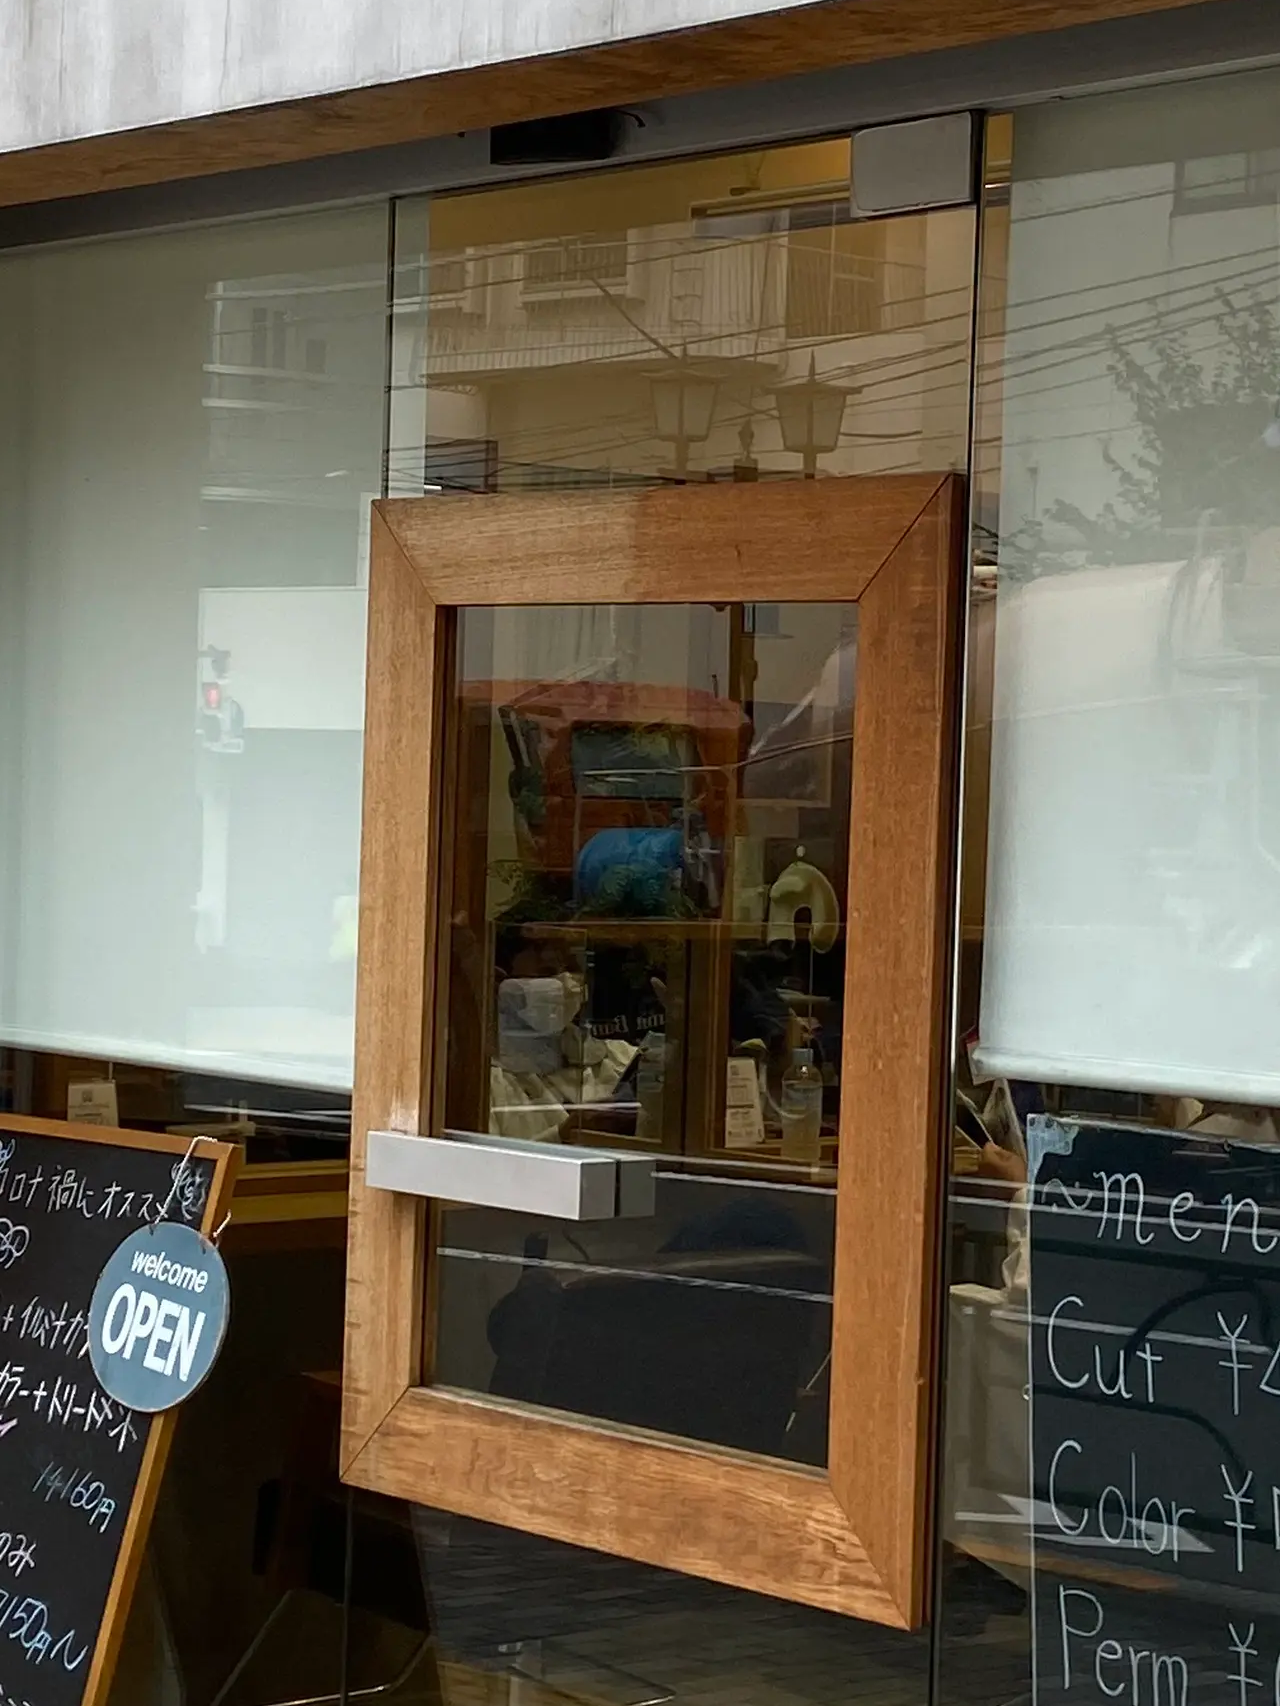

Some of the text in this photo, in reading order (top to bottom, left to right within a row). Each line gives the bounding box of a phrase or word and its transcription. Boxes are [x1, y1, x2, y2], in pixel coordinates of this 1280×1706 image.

[131, 1250, 209, 1293] welcome
[102, 1283, 206, 1382] OPEN
[1046, 1295, 1164, 1404] Cut
[1048, 1439, 1196, 1563] Color
